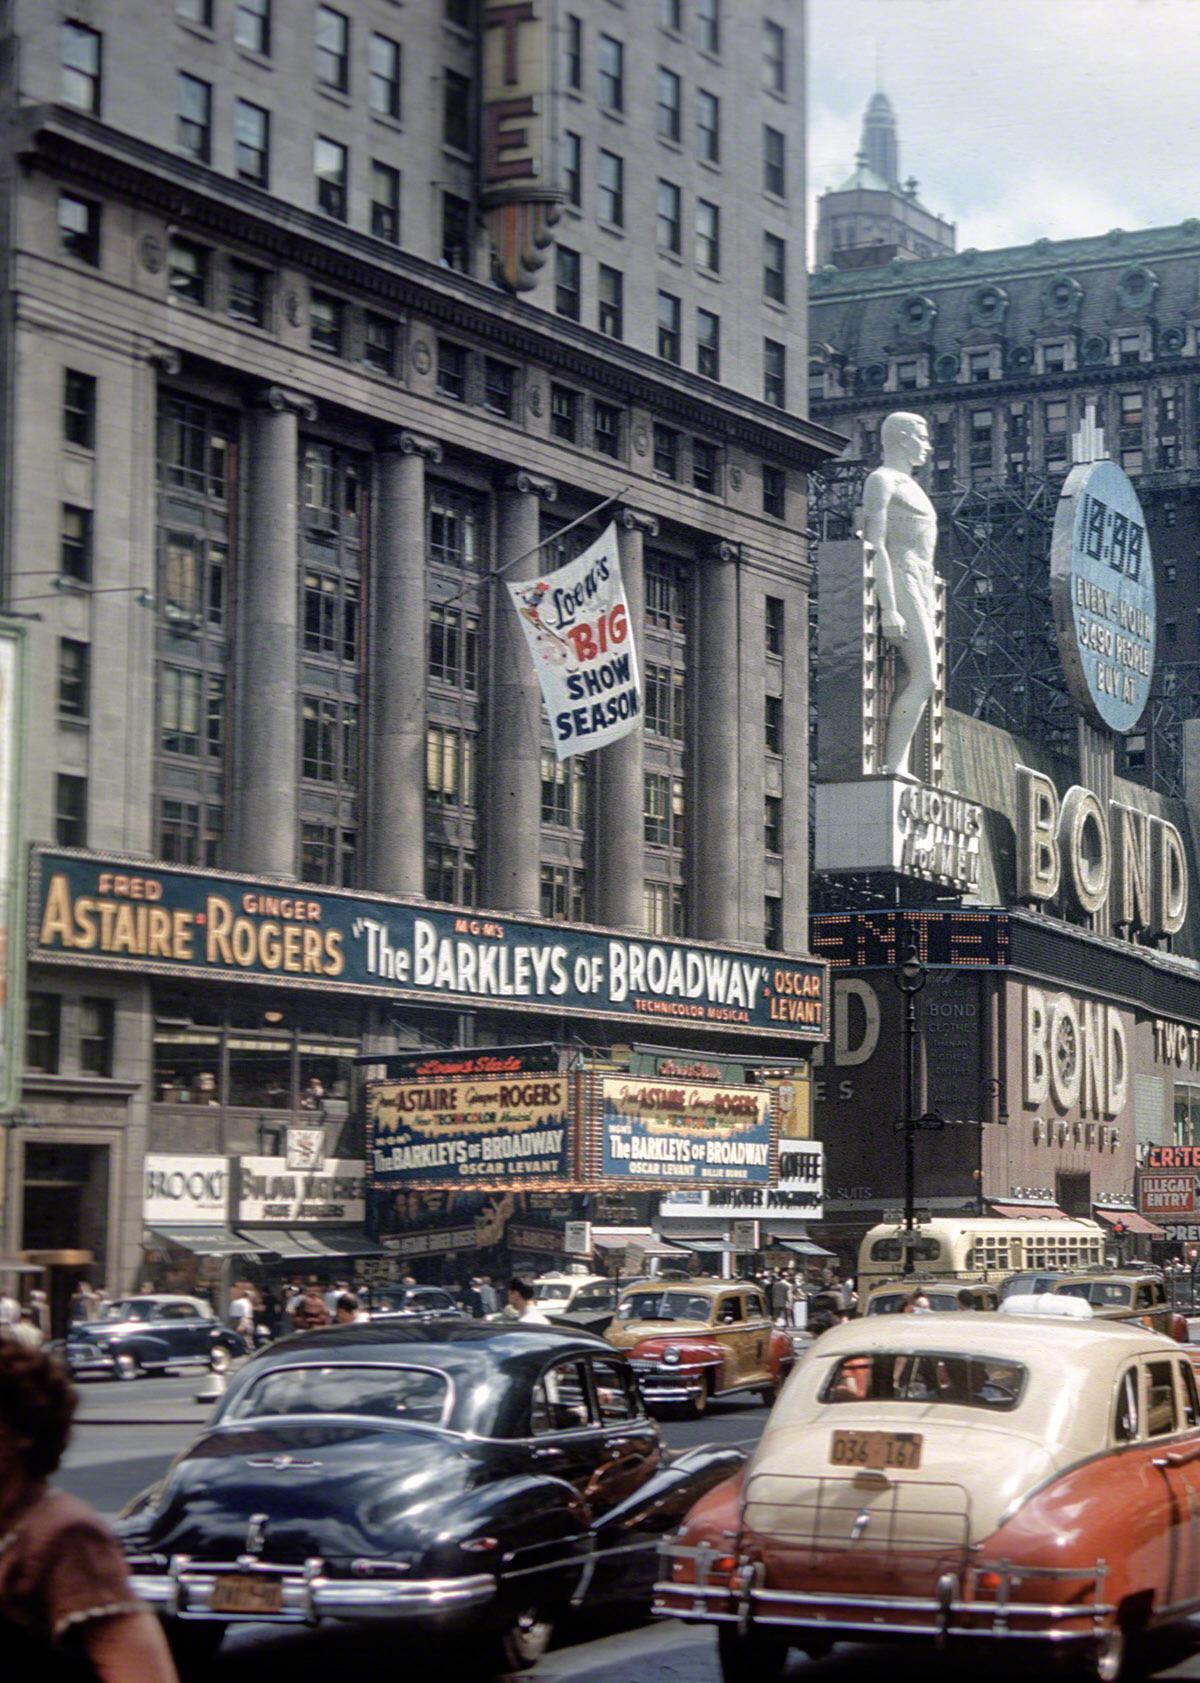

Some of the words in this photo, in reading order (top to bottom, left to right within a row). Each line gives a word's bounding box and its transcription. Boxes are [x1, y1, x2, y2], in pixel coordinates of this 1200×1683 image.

[567, 604, 627, 662] BIG
[1118, 596, 1150, 643] HOUR
[1115, 632, 1149, 678] PEOPLE
[566, 653, 631, 700] SHOW
[1096, 661, 1119, 698] BUY
[1122, 676, 1135, 705] AT
[556, 686, 640, 741] SEASON
[1015, 763, 1189, 938] BOND
[98, 873, 163, 900] FRED
[243, 893, 322, 922] GINGER
[40, 874, 195, 960] ASTAIRE
[206, 896, 345, 977] ROGERS
[413, 919, 568, 997] BARKLEYS
[574, 957, 603, 994] OF
[774, 969, 820, 996] OSCAR
[634, 999, 704, 1019] TECHNICOLOR
[707, 1005, 749, 1023] MUSICAL
[770, 998, 822, 1024] LEVANT
[929, 1003, 977, 1017] BOND
[928, 1021, 979, 1034] CLOTHES
[1156, 1020, 1188, 1062] TWO
[1026, 985, 1128, 1117] BOND
[398, 1088, 458, 1112] ASTAIRE
[500, 1083, 562, 1108] ROGERS
[392, 1139, 469, 1170] BARKLEYS
[481, 1129, 565, 1161] BROADWAY
[610, 1135, 632, 1160] The
[631, 1136, 693, 1162] BARKLEYS
[691, 1145, 706, 1160] OF
[706, 1140, 769, 1166] BROADWAY
[458, 1162, 504, 1175] OSCAR
[507, 1160, 559, 1174] LEVANT
[629, 1163, 660, 1175] OSCAR
[662, 1163, 697, 1176] LEVANT
[1143, 1178, 1193, 1193] ILLEGAL
[1147, 1193, 1190, 1207] ENTRY
